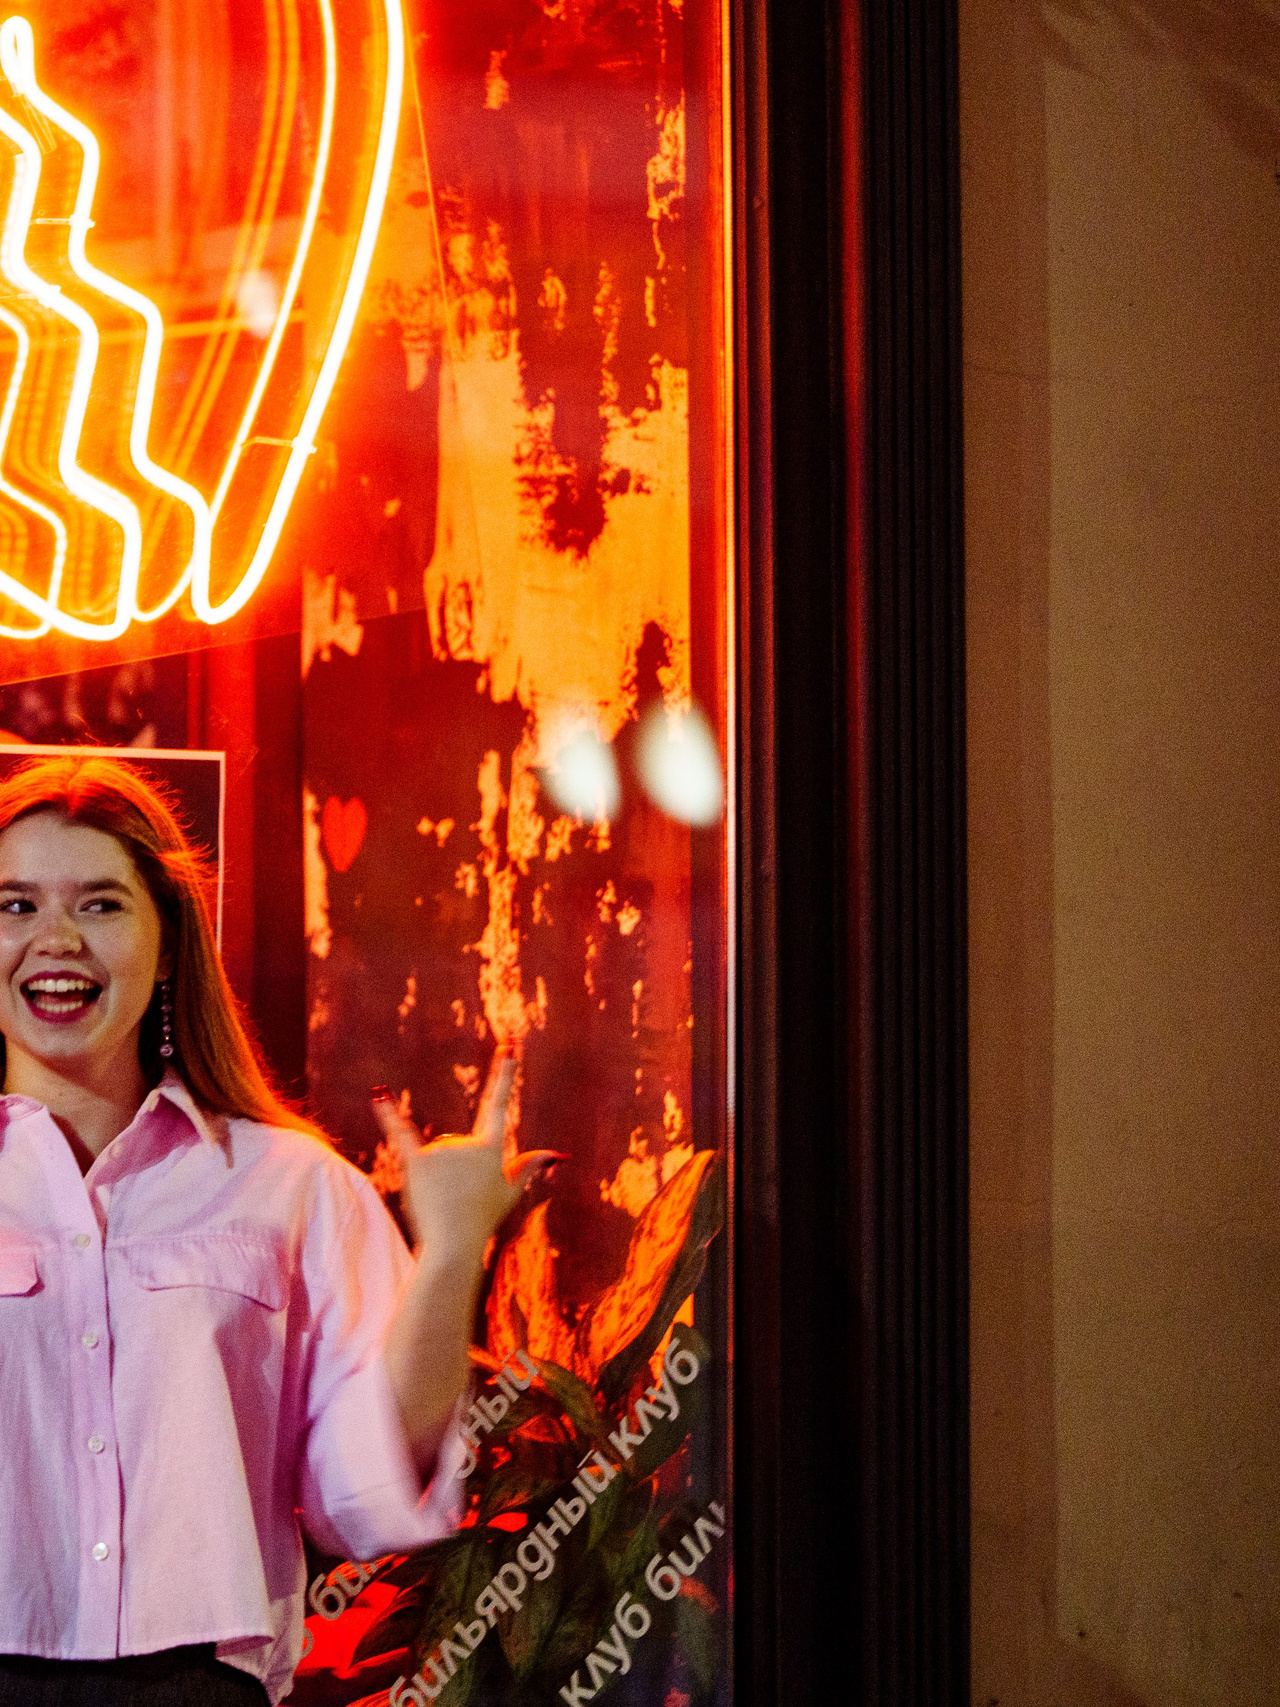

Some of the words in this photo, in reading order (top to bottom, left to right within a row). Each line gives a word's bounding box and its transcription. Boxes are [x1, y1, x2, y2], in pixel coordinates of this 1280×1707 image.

[390, 1449, 618, 1707] бильярдный
[609, 1337, 700, 1460] клуб
[559, 1591, 651, 1707] клуб
